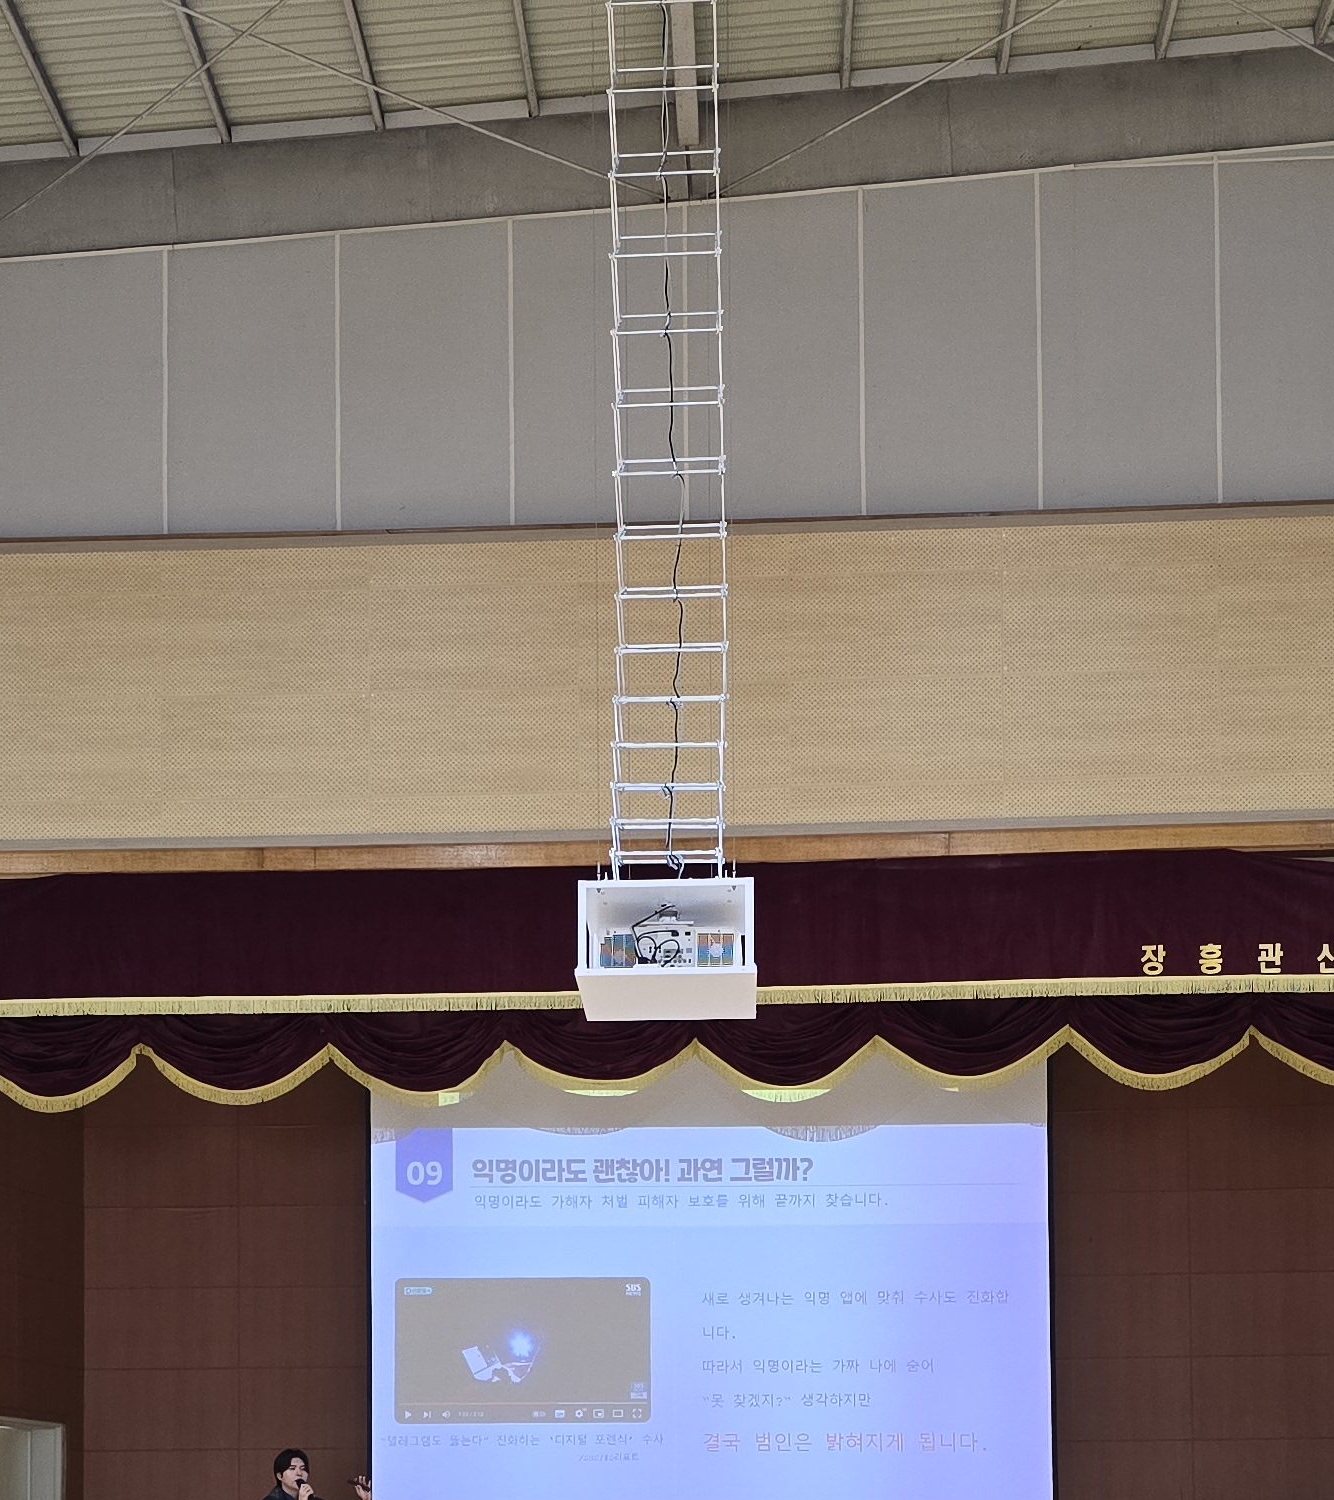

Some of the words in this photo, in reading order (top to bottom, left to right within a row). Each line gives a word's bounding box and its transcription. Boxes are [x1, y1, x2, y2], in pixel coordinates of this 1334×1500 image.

[406, 1161, 443, 1186] 09
[472, 1159, 588, 1184] 익명이라도
[593, 1158, 670, 1183] 괜찮아!
[677, 1158, 723, 1183] 과연
[730, 1157, 814, 1182] 그럴까?
[474, 1195, 543, 1210] 익명이라도
[552, 1195, 593, 1210] 가해자
[602, 1194, 629, 1209] 처벌
[638, 1194, 679, 1209] 피해자
[738, 1194, 765, 1208] 위해
[775, 1193, 815, 1208] 끝까지
[825, 1193, 889, 1208] 찾습니다.
[702, 1292, 730, 1306] 새로
[738, 1292, 794, 1306] 생겨나는
[804, 1291, 830, 1305] 익명
[840, 1290, 867, 1305] 앱에
[877, 1290, 904, 1304] 맞춰
[914, 1290, 957, 1305] 수사도
[967, 1290, 1009, 1304] 진화합
[702, 1326, 736, 1340] 니다.
[702, 1360, 743, 1374] 따라서
[753, 1359, 823, 1374] 익명이라는
[833, 1359, 860, 1373] 가짜
[870, 1359, 897, 1373] 나에
[906, 1358, 934, 1373] 숨어
[801, 1393, 871, 1407] 생각하지만
[642, 1434, 665, 1445] 수사
[704, 1432, 741, 1452] 결국
[756, 1432, 813, 1452] 범인은
[826, 1432, 903, 1452] 밝혀지게
[919, 1432, 987, 1452] 됩니다.
